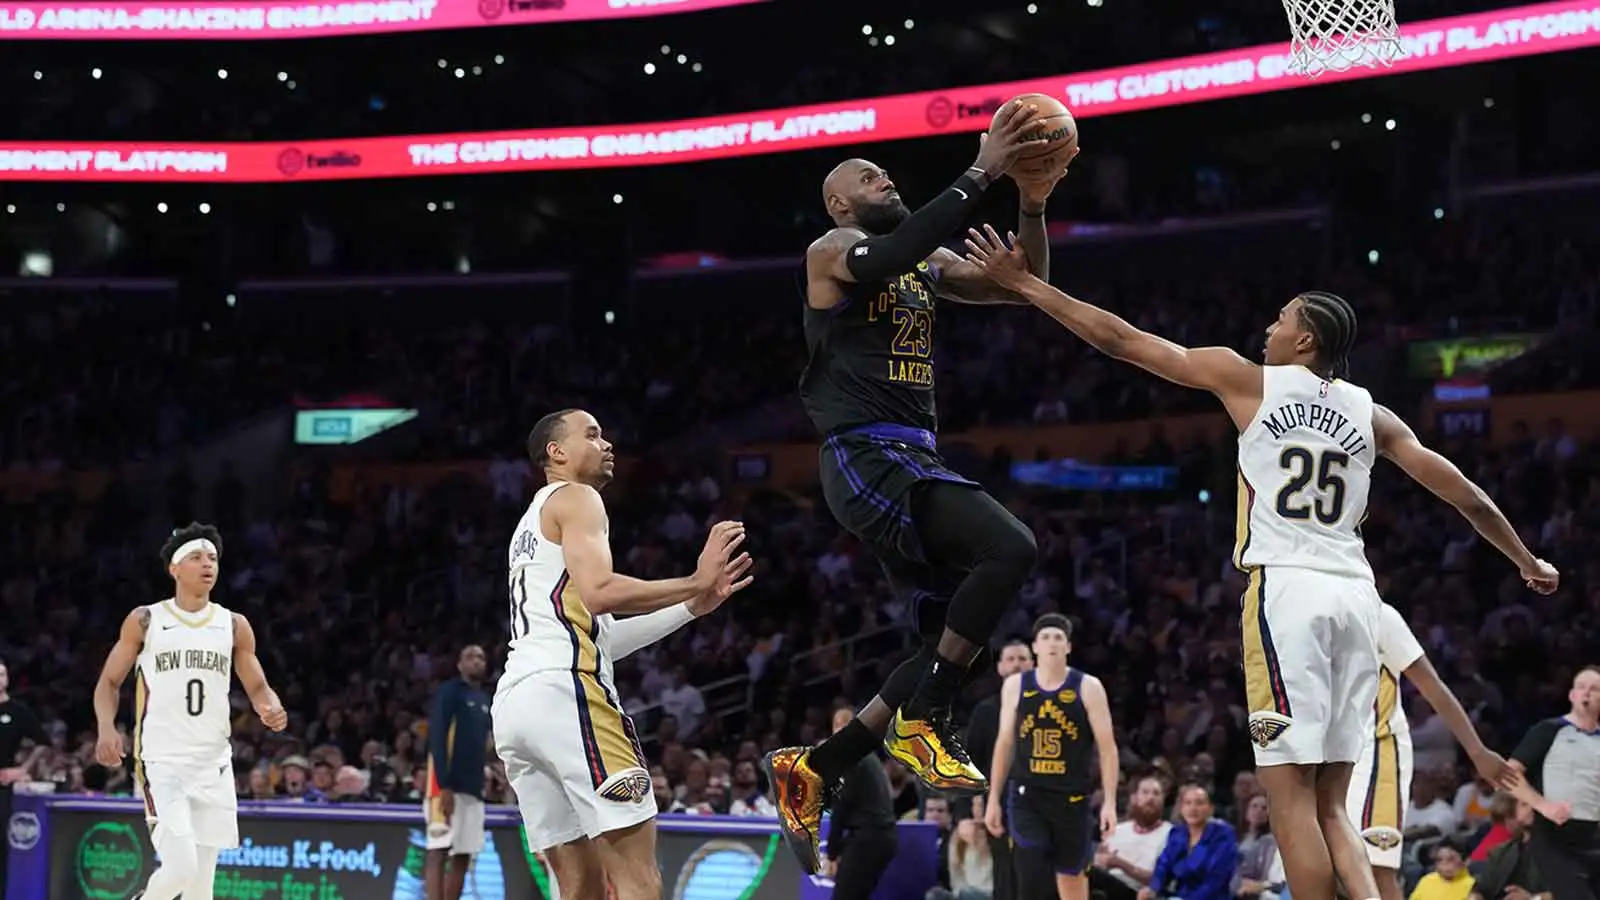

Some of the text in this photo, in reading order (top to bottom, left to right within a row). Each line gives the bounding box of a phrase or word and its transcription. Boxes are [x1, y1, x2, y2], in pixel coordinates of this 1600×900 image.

[266, 0, 438, 28] ENGAGEMENT
[1066, 79, 1117, 106] THE
[1118, 58, 1255, 100] CUSTOMER
[1446, 8, 1600, 53] PLATFORM
[408, 108, 876, 166] THE CUSTOMER ENGAGEMENT PLATFORM
[94, 151, 227, 172] PLATFORM
[868, 283, 897, 322] LOS
[891, 307, 932, 358] 23
[888, 360, 933, 386] LAKERS
[1262, 403, 1367, 456] MURPHY III
[1276, 445, 1350, 527] 25
[155, 649, 230, 677] NEW ORLEANS
[185, 678, 205, 717] 0
[1032, 729, 1062, 758] 15
[293, 840, 382, 877] K-Food,
